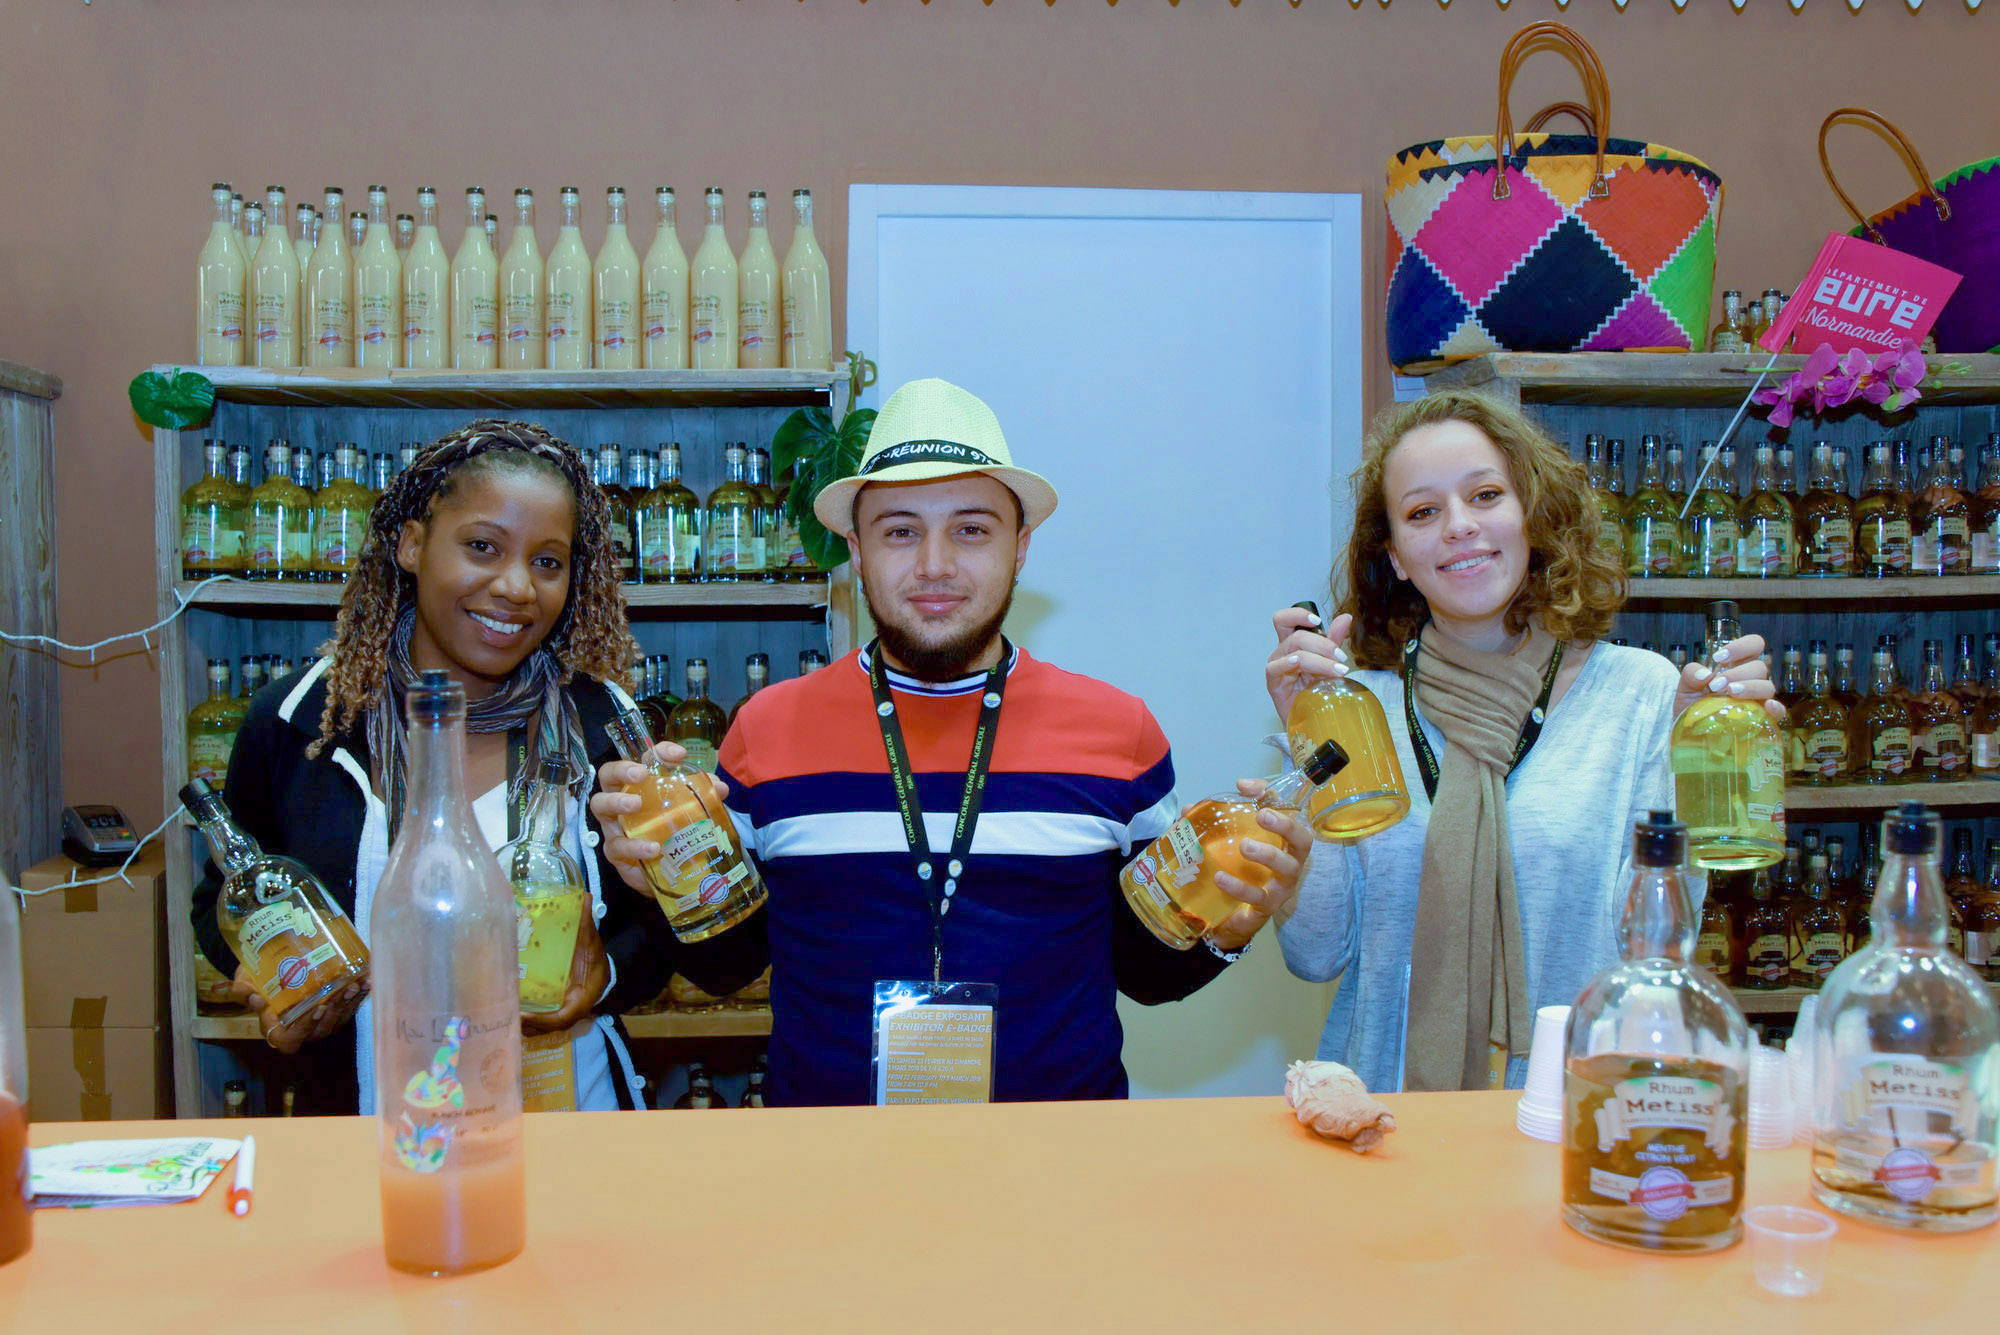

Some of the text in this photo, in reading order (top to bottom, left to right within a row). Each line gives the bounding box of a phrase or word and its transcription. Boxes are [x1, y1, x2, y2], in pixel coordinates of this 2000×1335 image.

[1813, 275, 1924, 330] eure
[1912, 295, 1928, 305] DE
[1804, 305, 1902, 349] Normandie
[890, 442, 965, 459] RÉUNION
[884, 732, 916, 844] CONCOURS GÉNÉRAL AGRICOLE
[955, 725, 986, 838] CONCOURS GÉNÉRAL AGRICOLE
[674, 826, 699, 844] Rhum
[668, 830, 715, 860] Metiss
[248, 910, 274, 928] Rhum
[246, 913, 292, 945] Metiss
[935, 1012, 987, 1021] EXPOSANT
[889, 1022, 992, 1033] EXHIBITOR E-BADGE
[1892, 1063, 1940, 1079] Rhum
[1648, 1081, 1696, 1095] Rhum
[1869, 1079, 1961, 1100] Metiss
[1625, 1098, 1714, 1115] Metiss
[1647, 1143, 1686, 1154] MENTHE
